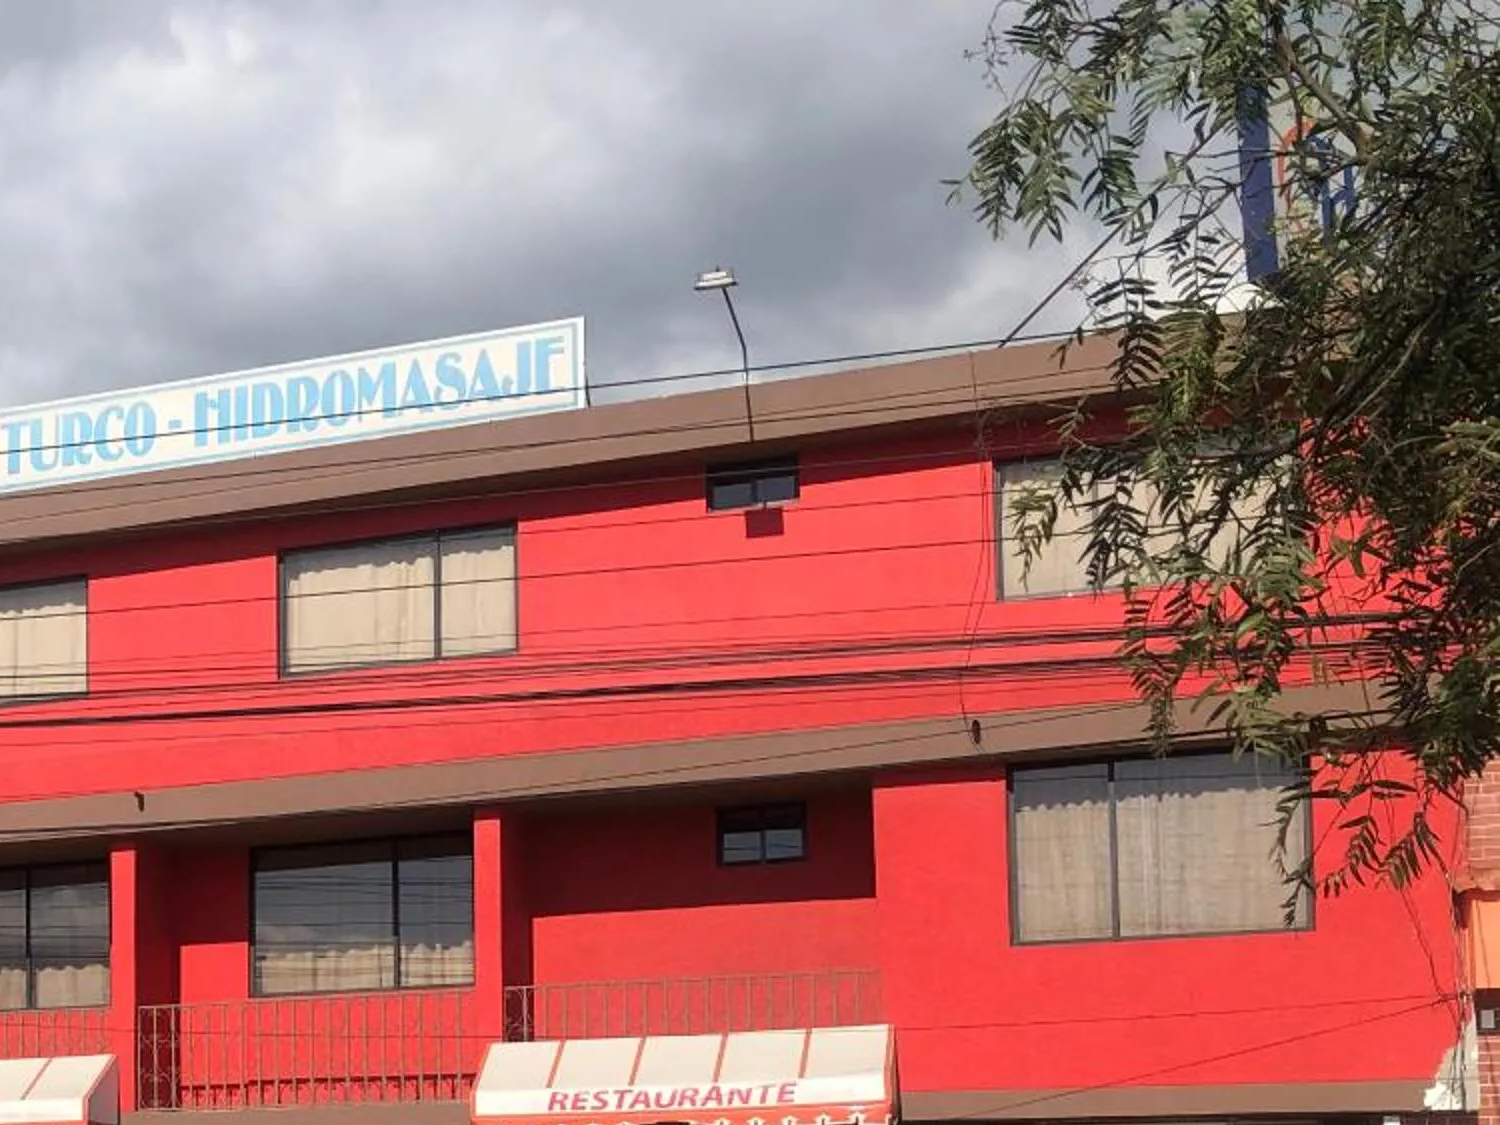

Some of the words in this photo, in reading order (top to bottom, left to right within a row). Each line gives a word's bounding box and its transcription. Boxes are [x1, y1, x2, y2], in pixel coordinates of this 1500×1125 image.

[0, 401, 157, 476] TURCO
[194, 335, 566, 448] HIDROMASAJE
[548, 1082, 798, 1111] RESTAURANTE
